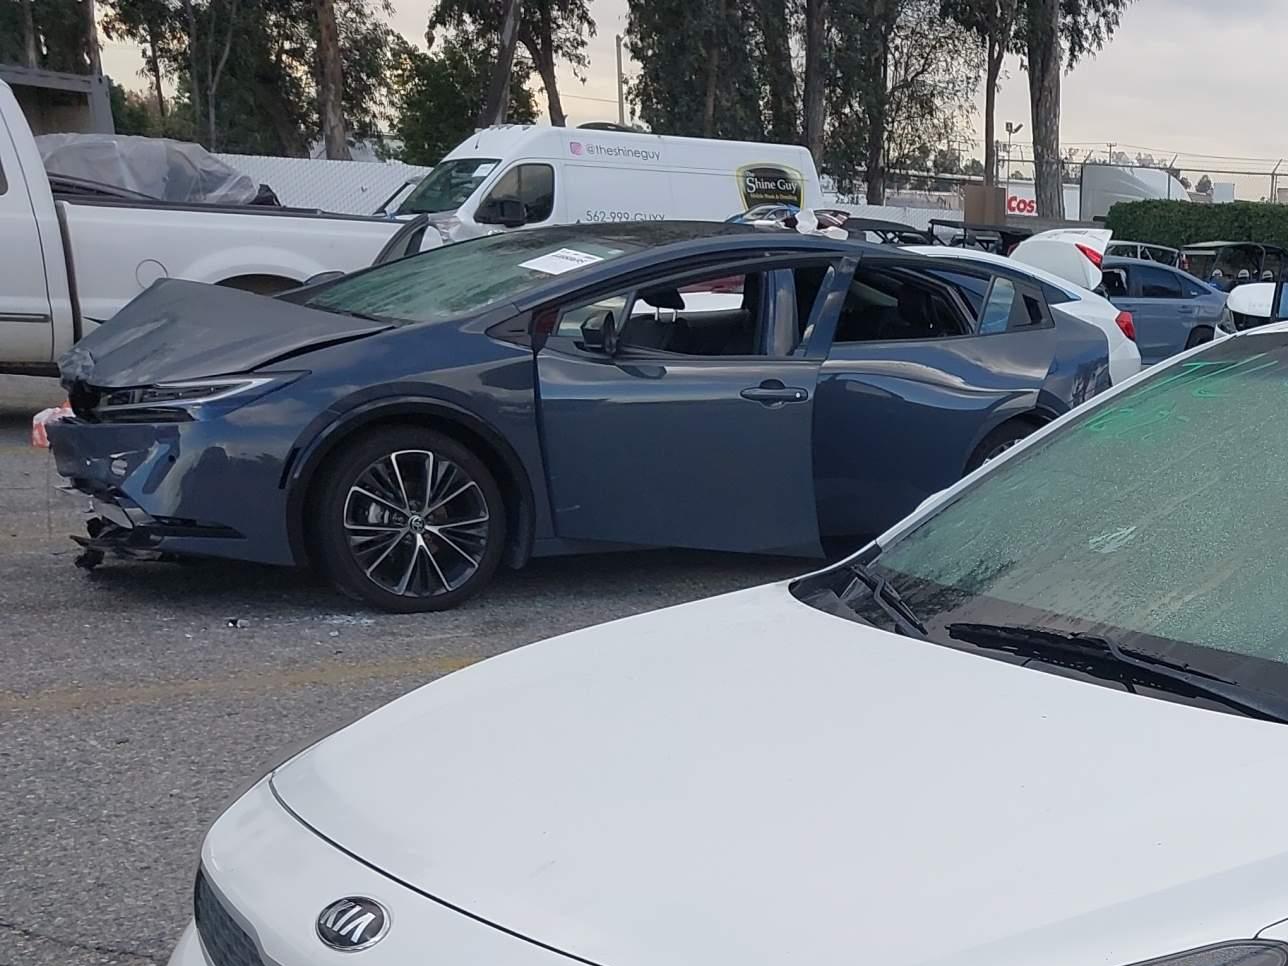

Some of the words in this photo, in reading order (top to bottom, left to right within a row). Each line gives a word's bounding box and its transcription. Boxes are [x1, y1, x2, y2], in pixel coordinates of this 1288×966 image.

[586, 144, 661, 160] @theshineguy
[746, 177, 777, 193] Shine
[777, 179, 798, 194] Guy
